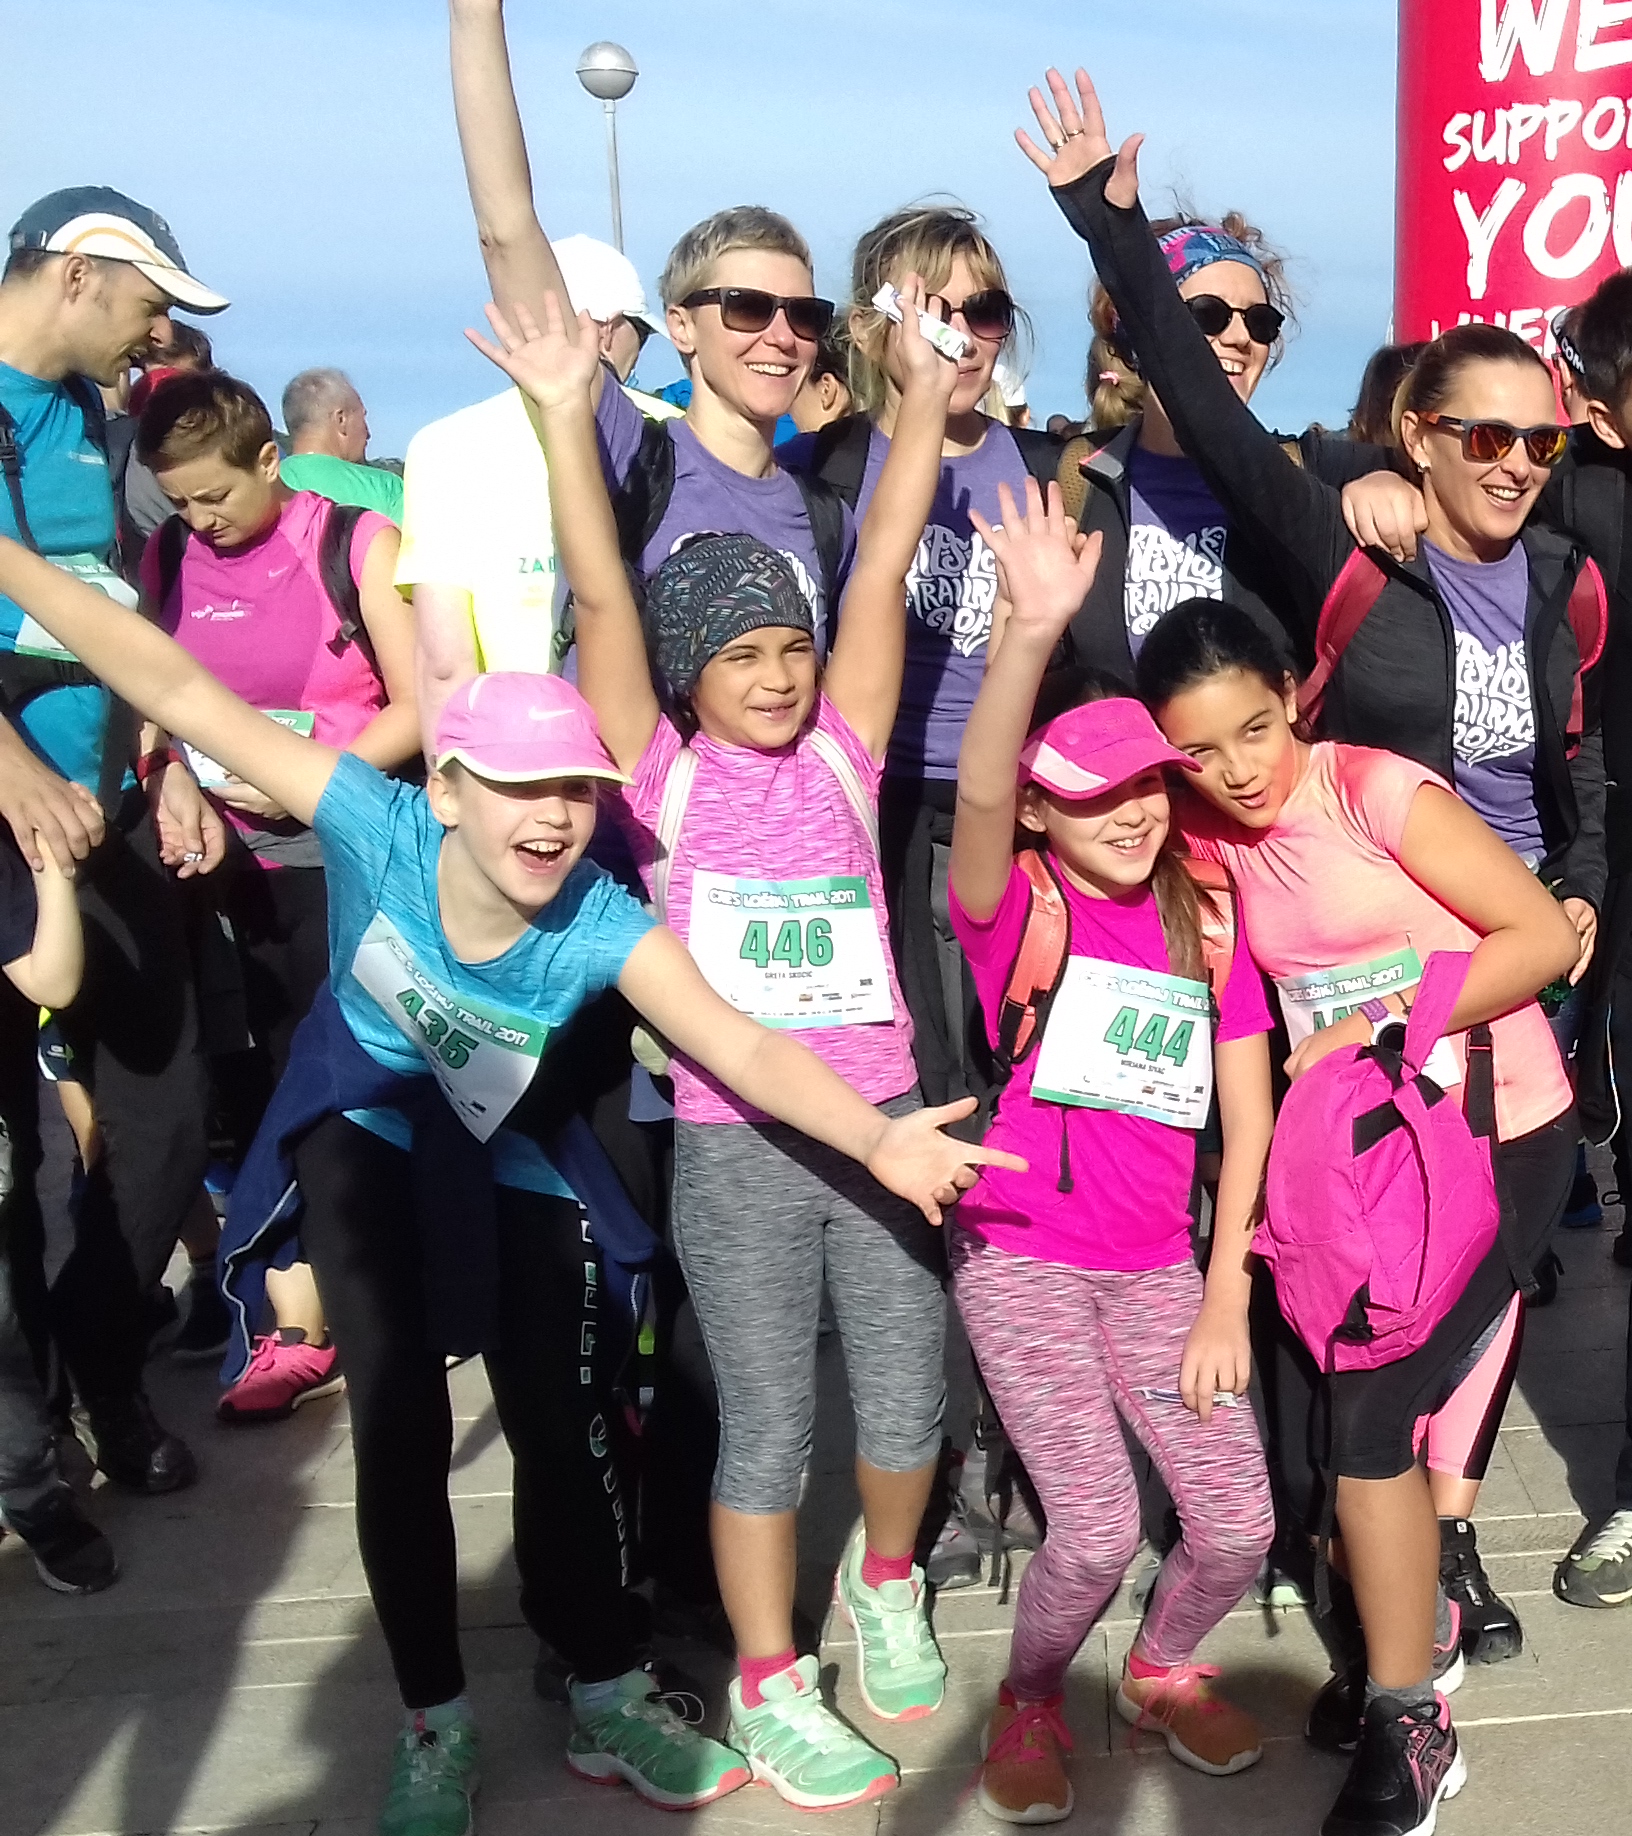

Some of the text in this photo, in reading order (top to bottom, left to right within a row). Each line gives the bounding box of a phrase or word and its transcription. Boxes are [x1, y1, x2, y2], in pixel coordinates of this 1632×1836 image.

[790, 891, 829, 908] TRAIL
[829, 889, 856, 905] 2017
[739, 918, 834, 968] 446
[1336, 975, 1372, 994] TRAIL
[1370, 963, 1404, 987] 2017
[396, 988, 480, 1069] 435
[456, 1007, 495, 1035] TRAIL
[494, 1026, 531, 1047] 2017
[1103, 1006, 1195, 1067] 444
